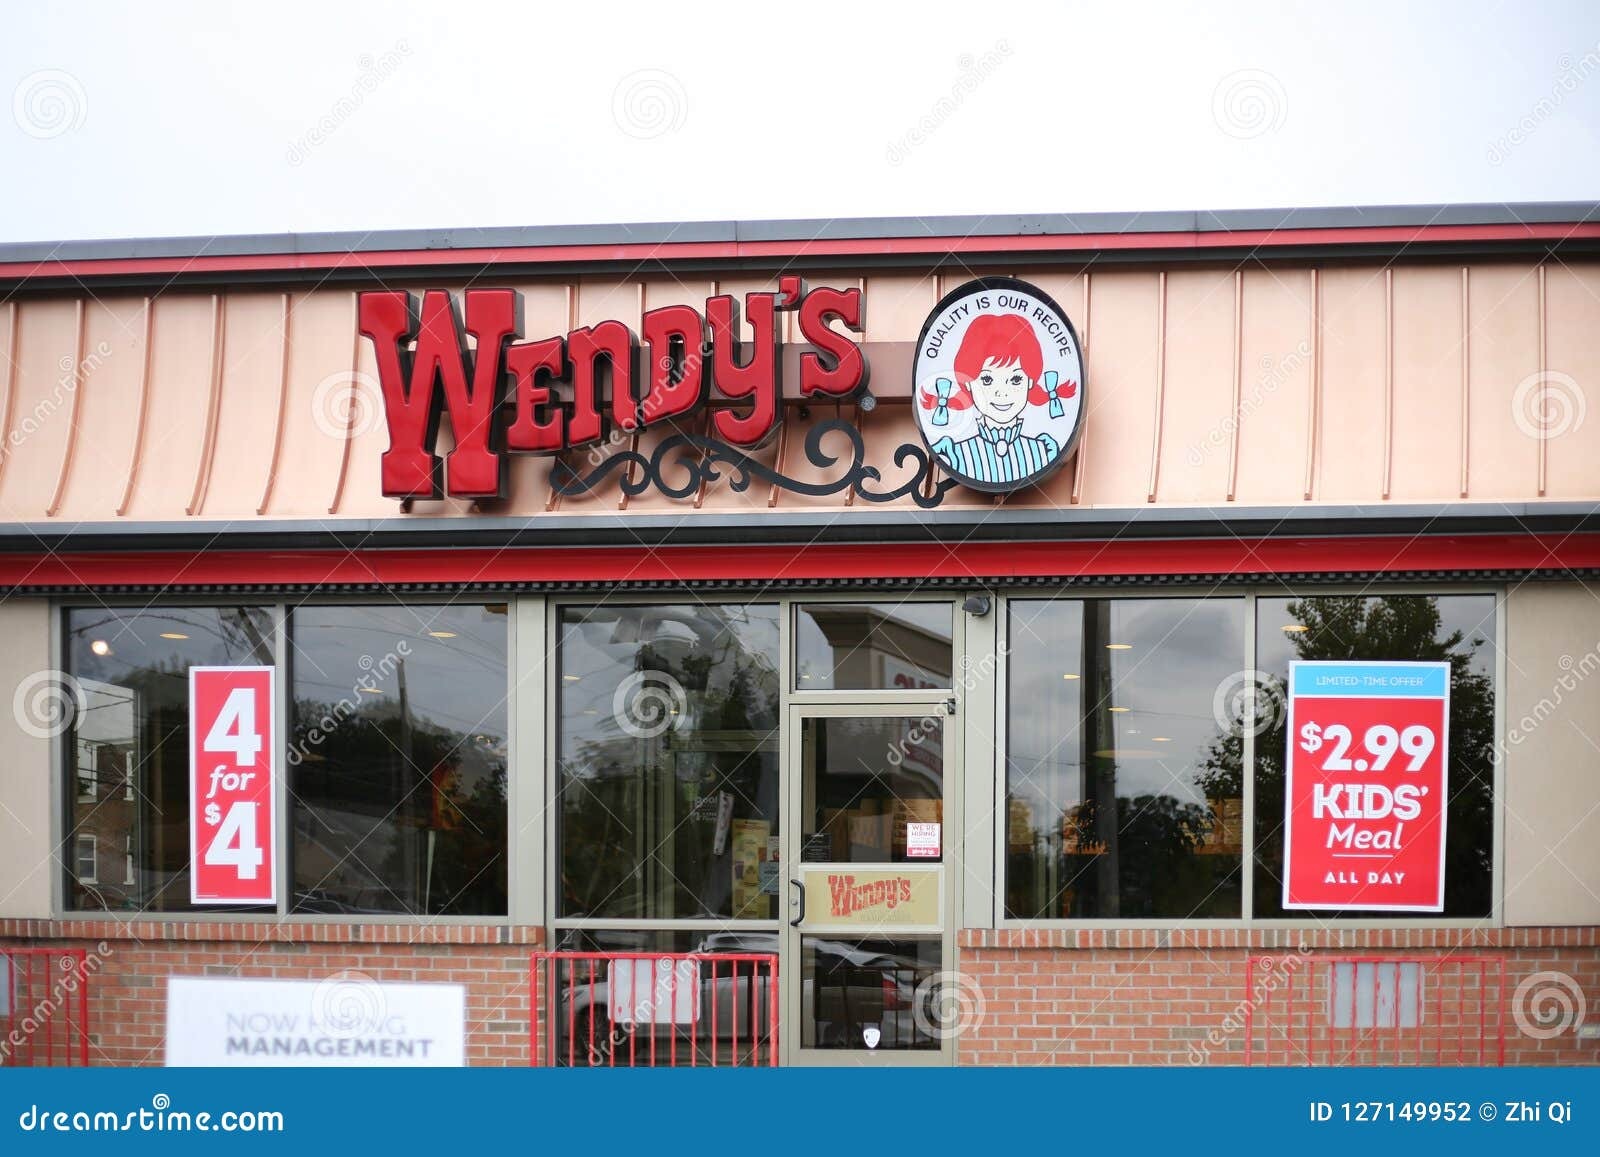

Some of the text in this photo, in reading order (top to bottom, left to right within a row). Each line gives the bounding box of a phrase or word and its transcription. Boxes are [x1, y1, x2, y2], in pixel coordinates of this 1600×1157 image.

[926, 295, 1072, 359] QUALITY IS OUR RECIPE
[1315, 675, 1424, 687] LIMITED-TIME OFFER
[203, 687, 262, 767] 4
[1300, 720, 1436, 772] $2.99
[206, 764, 256, 799] for
[1312, 783, 1430, 821] KIDS'
[1326, 822, 1404, 850] Meal
[1324, 872, 1405, 884] ALL DAY
[226, 1012, 298, 1034] NOW
[225, 1036, 433, 1058] MANAGEMENT
